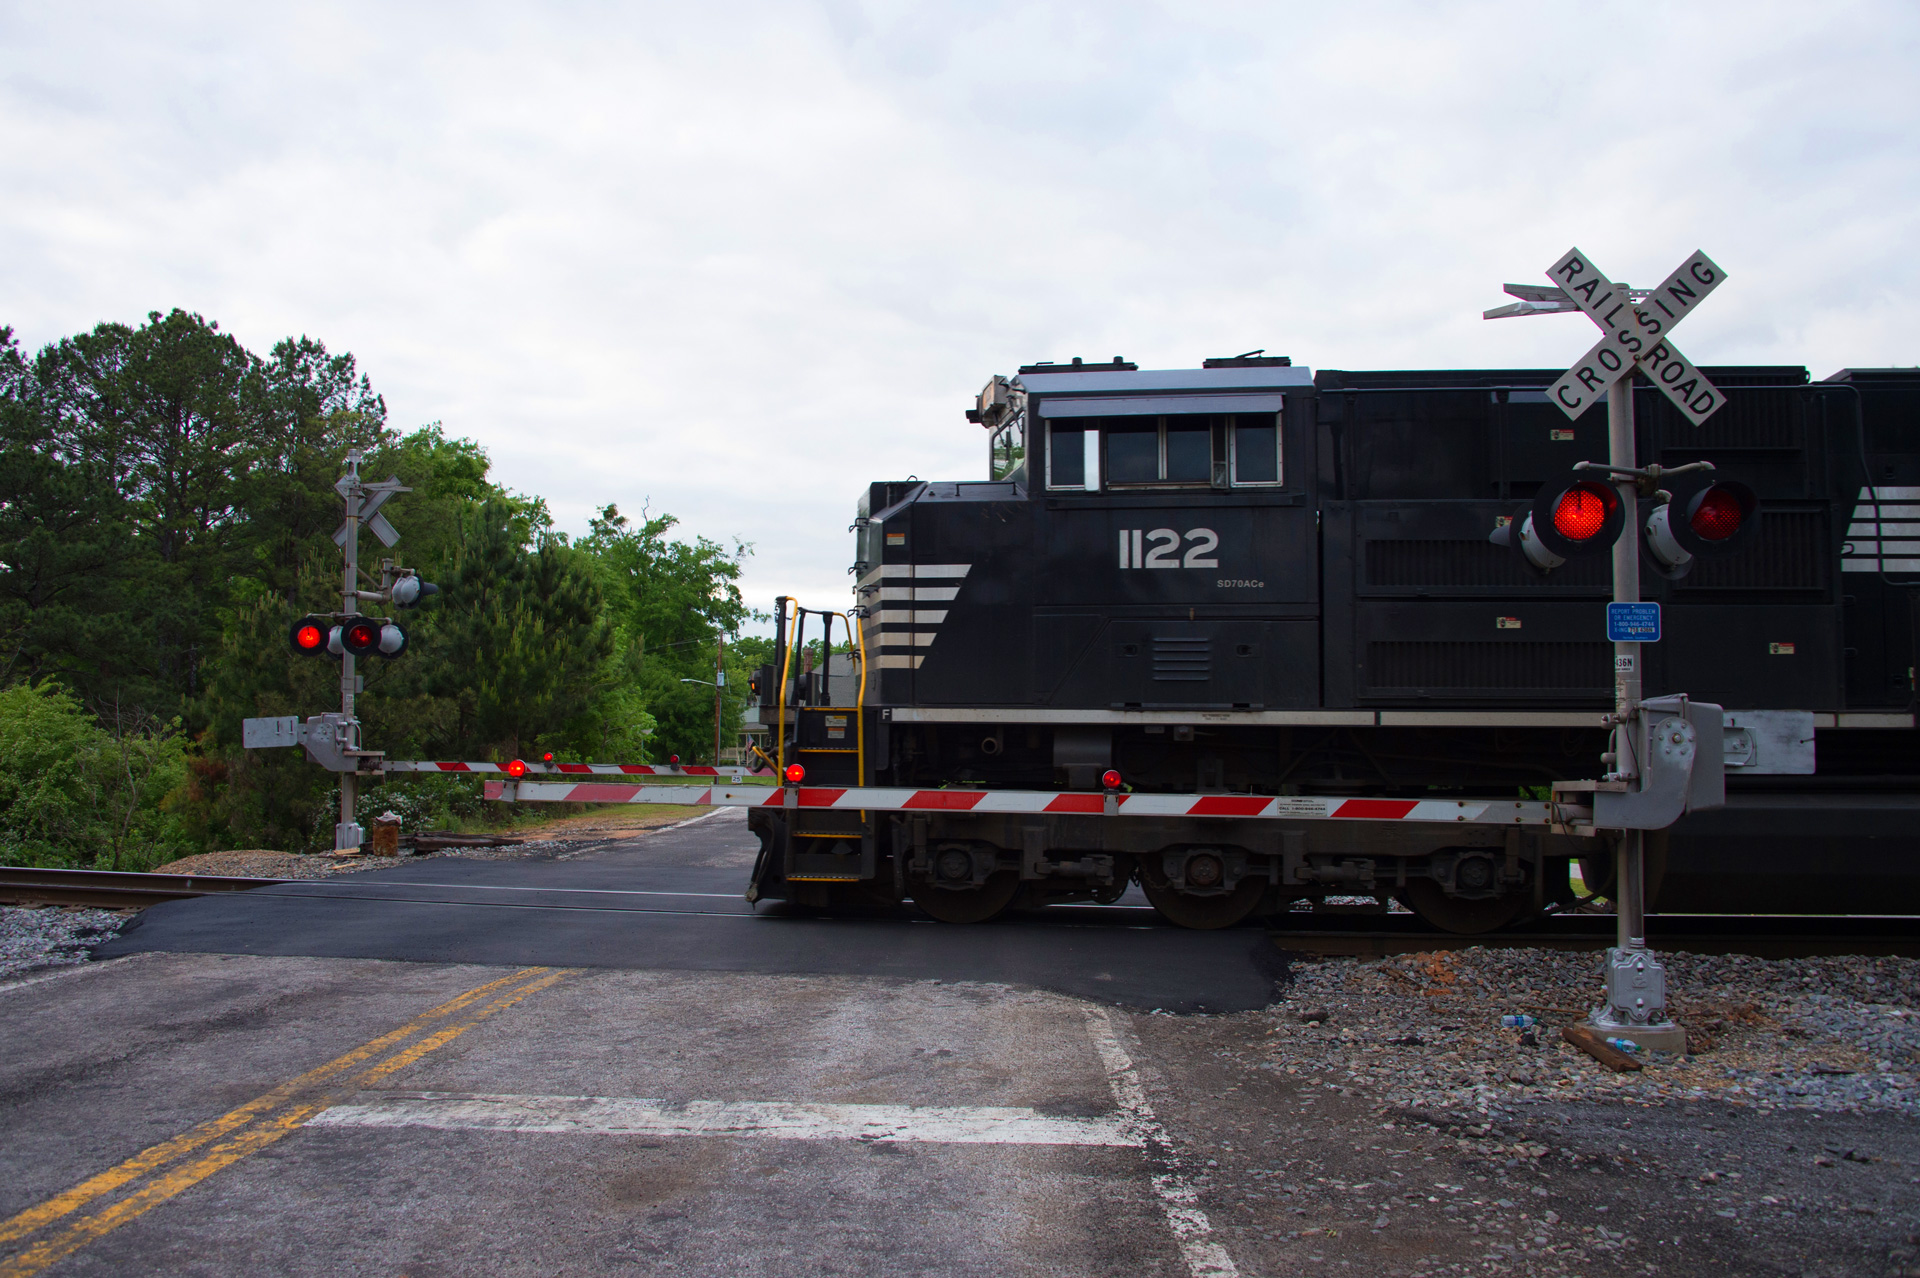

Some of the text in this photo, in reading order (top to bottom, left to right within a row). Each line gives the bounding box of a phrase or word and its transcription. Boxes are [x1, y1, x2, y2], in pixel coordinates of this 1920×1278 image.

[1557, 261, 1715, 409] CROSSING
[1557, 256, 1715, 415] RAIL ROAD
[1119, 527, 1219, 569] 1122
[1216, 579, 1265, 588] SD70ACe
[882, 709, 890, 720] F
